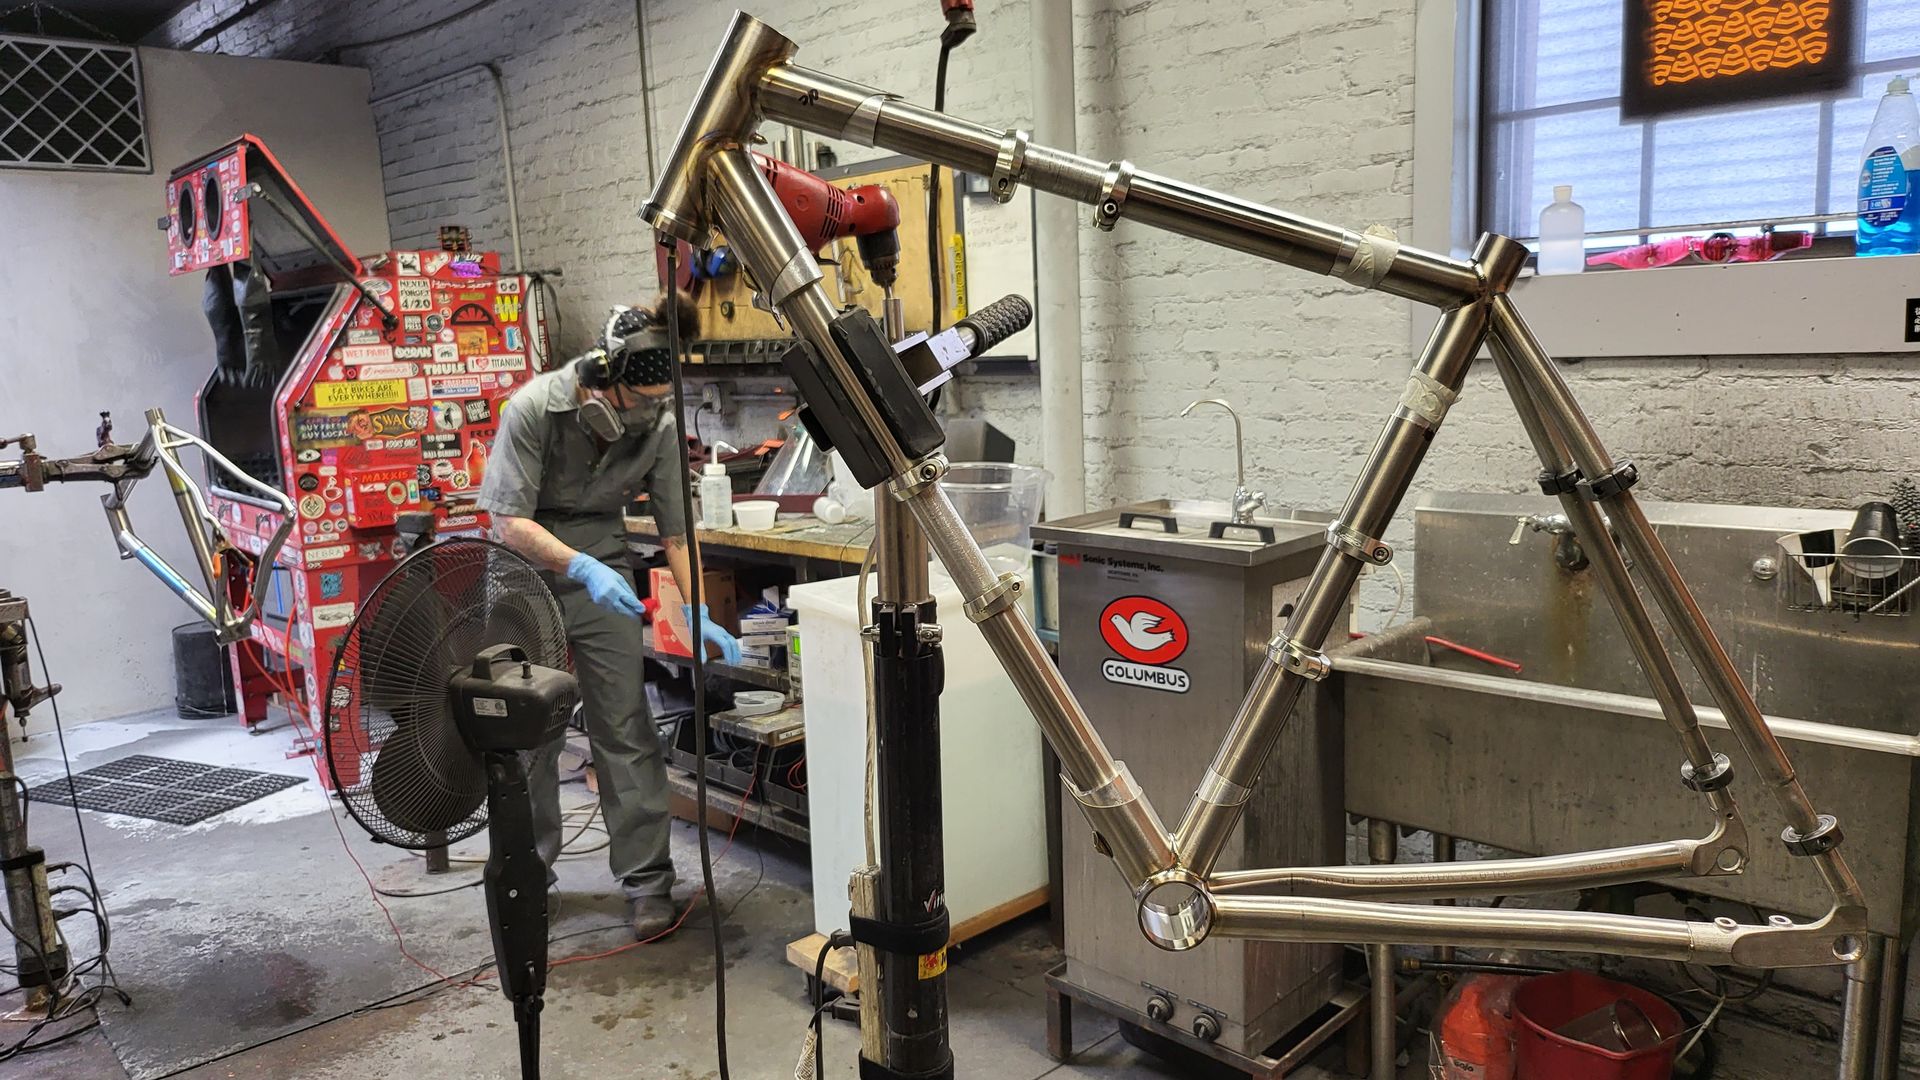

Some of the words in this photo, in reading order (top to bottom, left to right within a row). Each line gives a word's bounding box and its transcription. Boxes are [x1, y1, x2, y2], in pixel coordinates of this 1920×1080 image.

[399, 280, 429, 288] NEVER
[402, 298, 431, 309] 4/20
[345, 349, 362, 358] WET
[491, 357, 523, 368] TITANIUM
[424, 362, 466, 375] THULE
[332, 387, 349, 395] FAT
[351, 386, 375, 395] BIKES
[377, 384, 393, 392] ARE
[321, 430, 350, 438] LOCAL
[362, 471, 409, 483] MAXXIS
[1083, 554, 1106, 565] Sonic
[1147, 562, 1164, 573] Inc.
[1105, 664, 1186, 688] COLUMBUS
